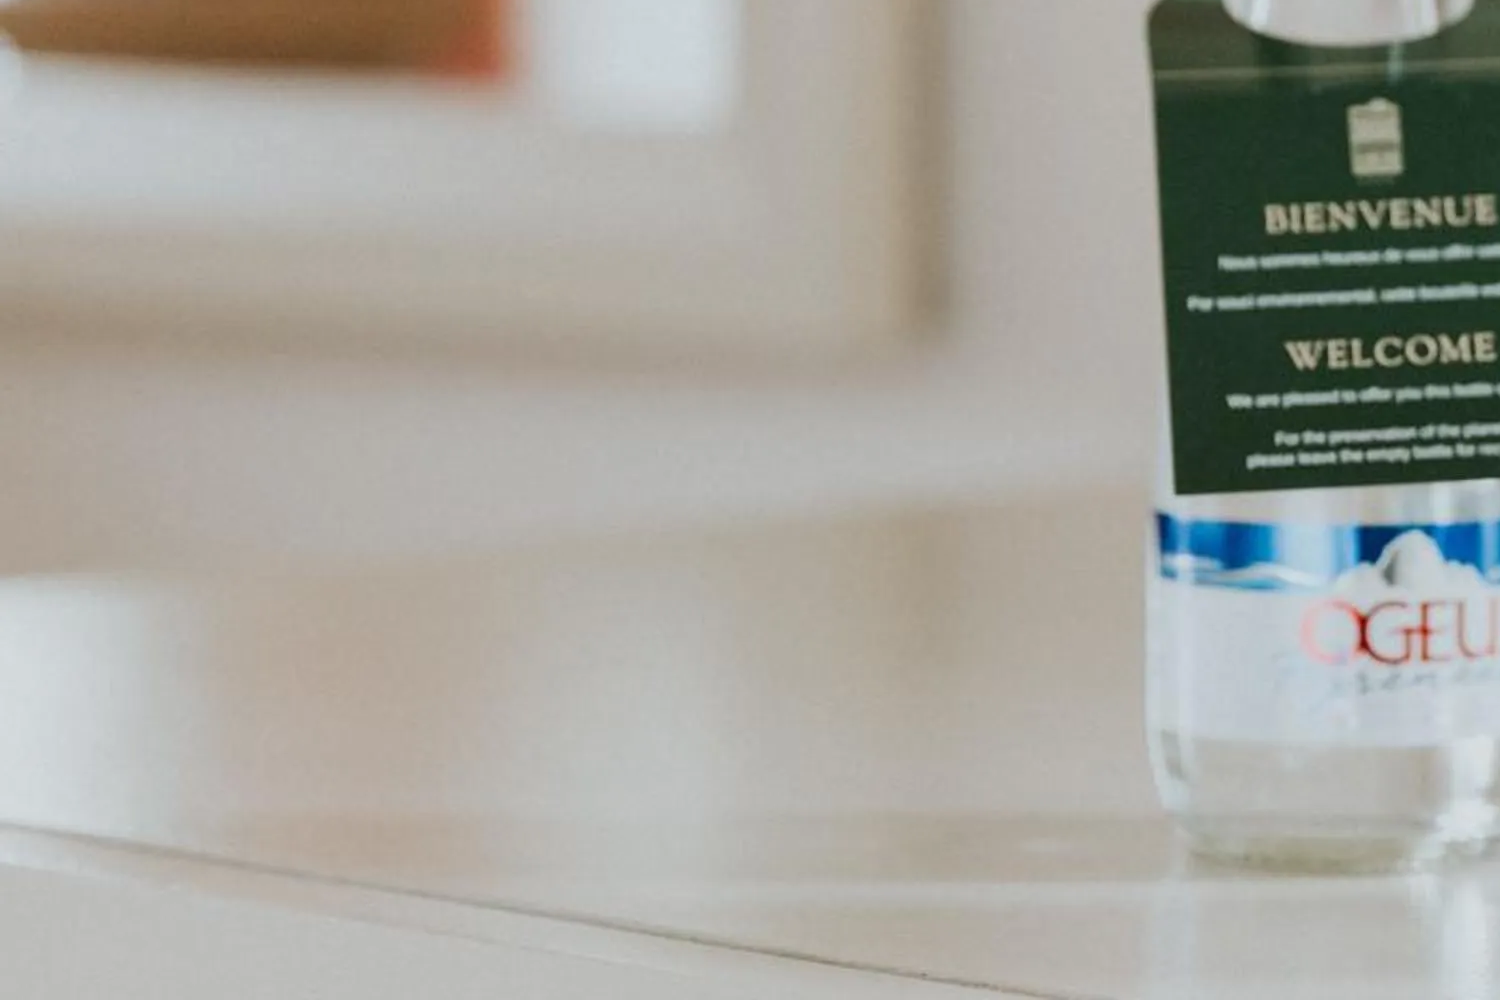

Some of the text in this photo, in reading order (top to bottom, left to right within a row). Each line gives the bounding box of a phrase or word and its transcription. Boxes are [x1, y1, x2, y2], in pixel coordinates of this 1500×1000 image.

[1264, 194, 1498, 235] BIENVENUE
[1284, 331, 1498, 371] WELCOME
[1301, 597, 1499, 665] OGEU
